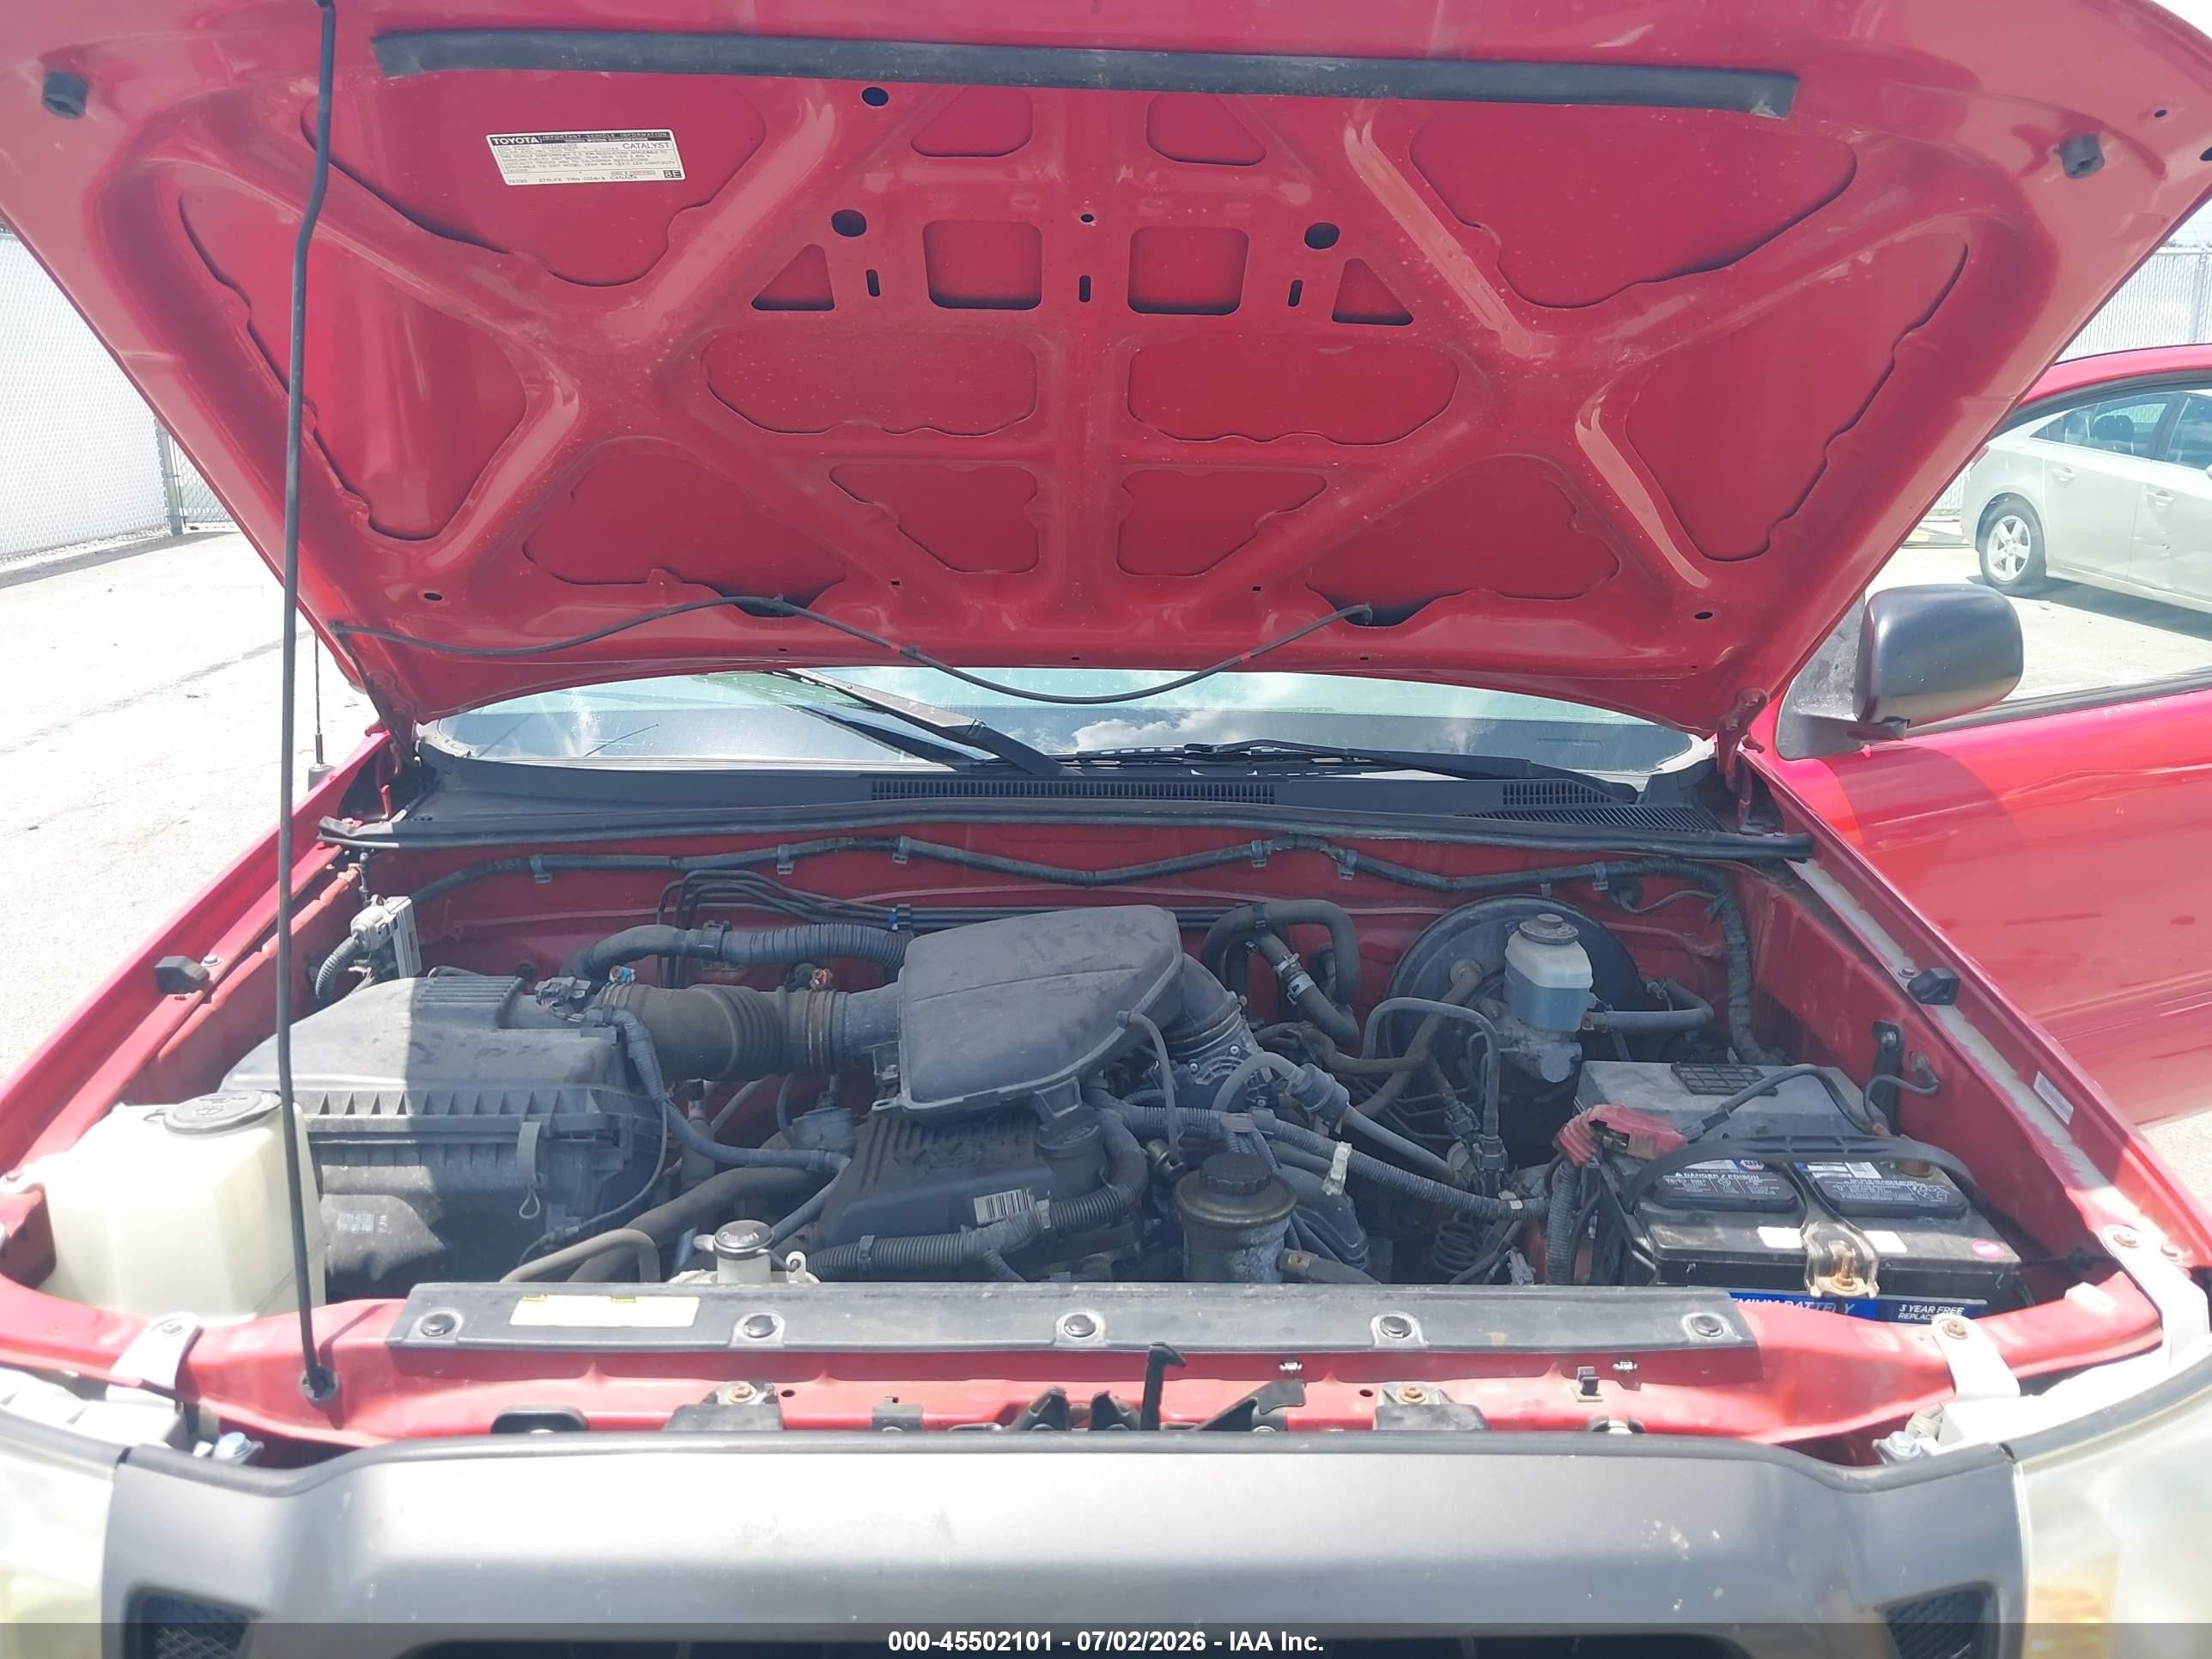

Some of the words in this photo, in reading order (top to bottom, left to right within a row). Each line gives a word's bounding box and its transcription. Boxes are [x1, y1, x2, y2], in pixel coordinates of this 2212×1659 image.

[492, 137, 539, 145] TOYOTA
[1909, 1304, 1936, 1314] YEAR
[1936, 1306, 1965, 1316] FREE
